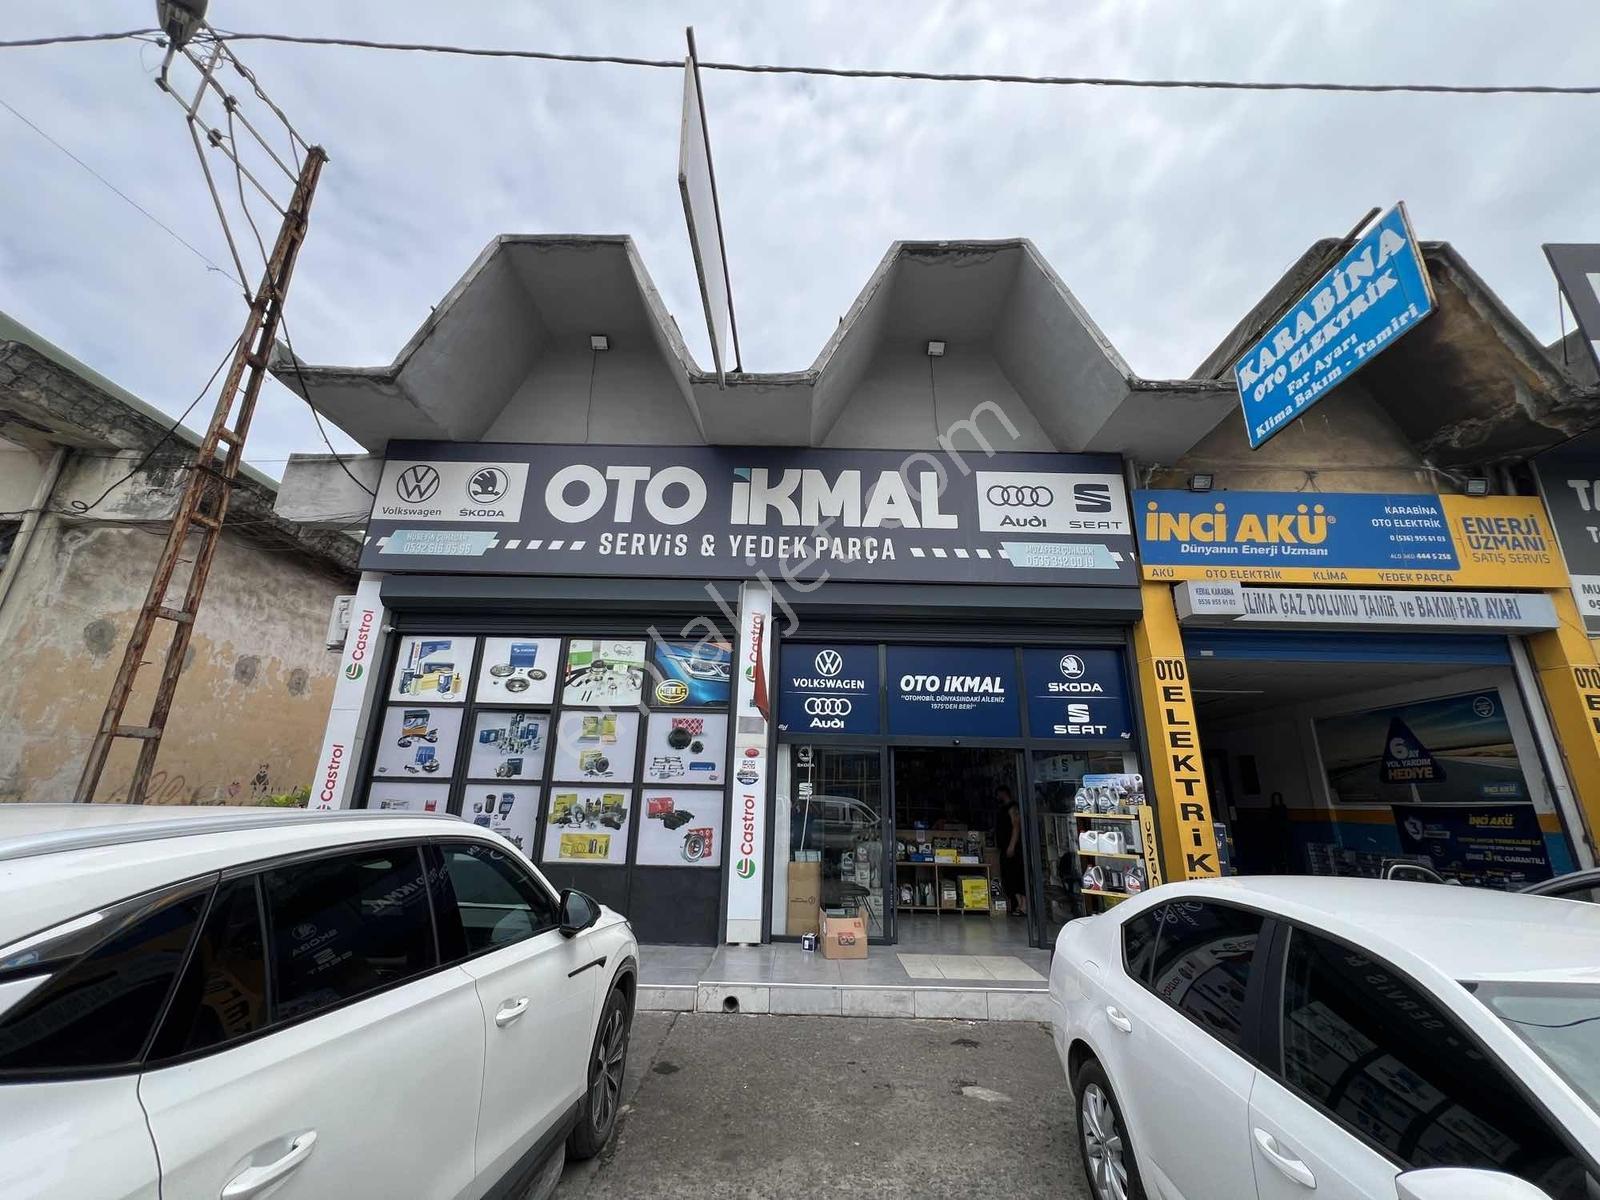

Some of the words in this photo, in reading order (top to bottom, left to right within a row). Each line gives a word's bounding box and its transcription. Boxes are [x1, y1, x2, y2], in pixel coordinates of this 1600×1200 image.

[1255, 404, 1293, 438] Klima
[1294, 366, 1343, 407] Bakım
[1354, 302, 1421, 359] Tamiri
[1286, 372, 1310, 396] Far
[1314, 334, 1358, 375] Ayarı
[1254, 365, 1287, 402] OTO
[545, 464, 707, 525] OTO
[382, 506, 442, 517] Volkswagen
[1000, 514, 1047, 528] Audi
[1069, 520, 1123, 530] SEAT
[1235, 504, 1328, 544] AKÜ
[1372, 518, 1391, 528] OTO
[1461, 514, 1541, 535] ENERJİ
[700, 534, 716, 557] &
[729, 535, 806, 560] YEDEK
[815, 536, 896, 563] PARÇA
[1181, 543, 1239, 555] Dünyanın
[1242, 544, 1278, 557] Enerji
[1282, 546, 1328, 556] Uzmanı
[1467, 535, 1546, 551] UZMANI
[1472, 552, 1507, 565] SATIŞ
[1205, 569, 1227, 578] OTO
[1378, 572, 1413, 582] YEDEK
[1416, 573, 1453, 584] PARÇA
[1307, 594, 1358, 617] DOLUMU
[1400, 601, 1413, 617] ve
[1486, 597, 1522, 620] AYARI
[352, 610, 375, 661] Castrol
[1155, 660, 1185, 681] OTO
[659, 687, 688, 696] HELLA
[793, 678, 865, 689] VOLKSWAGEN
[900, 674, 940, 692] OTO
[810, 717, 844, 729] Audi
[1053, 724, 1107, 735] SEAT
[320, 744, 345, 802] Castrol
[741, 795, 756, 855] Castrol
